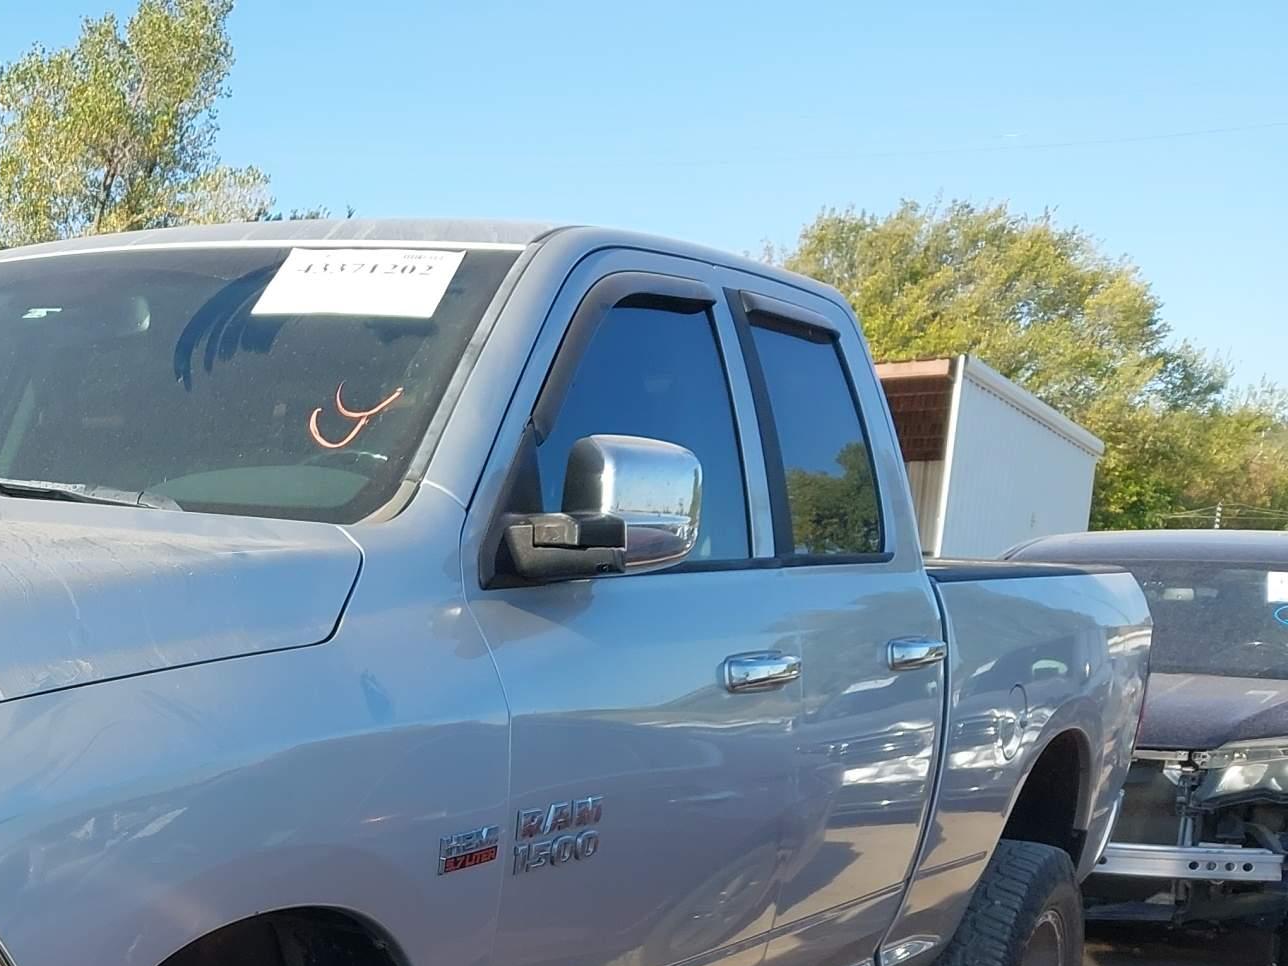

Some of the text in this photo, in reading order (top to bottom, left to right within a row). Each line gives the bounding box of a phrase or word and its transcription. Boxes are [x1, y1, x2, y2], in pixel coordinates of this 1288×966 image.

[296, 262, 435, 276] 43371202
[515, 796, 605, 841] RAM
[513, 829, 601, 876] 1500
